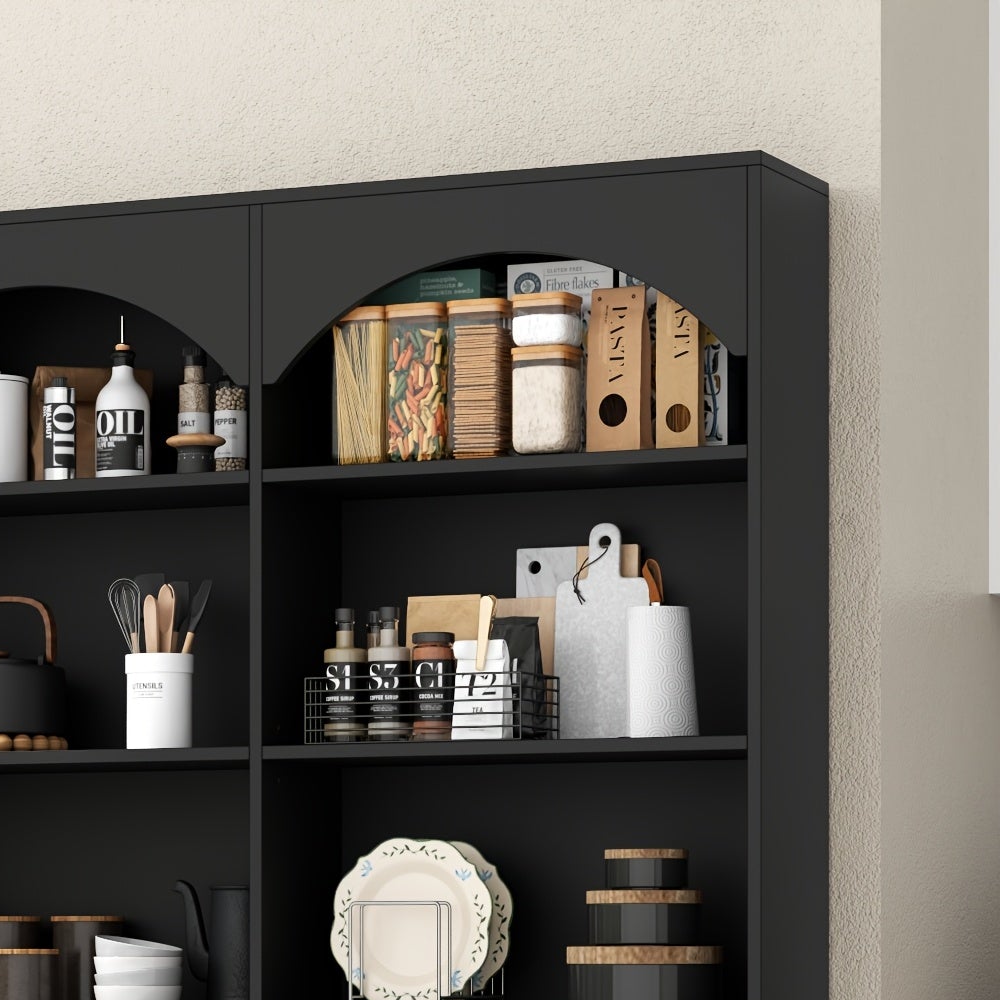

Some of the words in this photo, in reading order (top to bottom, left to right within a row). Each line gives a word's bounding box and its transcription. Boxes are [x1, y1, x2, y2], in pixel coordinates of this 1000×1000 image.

[546, 278, 570, 291] Fibre
[572, 276, 600, 289] flakes
[608, 306, 628, 383] PASTA
[674, 307, 690, 359] ASTA
[97, 410, 143, 436] OIL
[215, 417, 237, 426] PEPPER
[52, 404, 75, 467] OIL
[326, 664, 351, 691] S1
[369, 663, 400, 690] S3
[415, 661, 443, 689] C1
